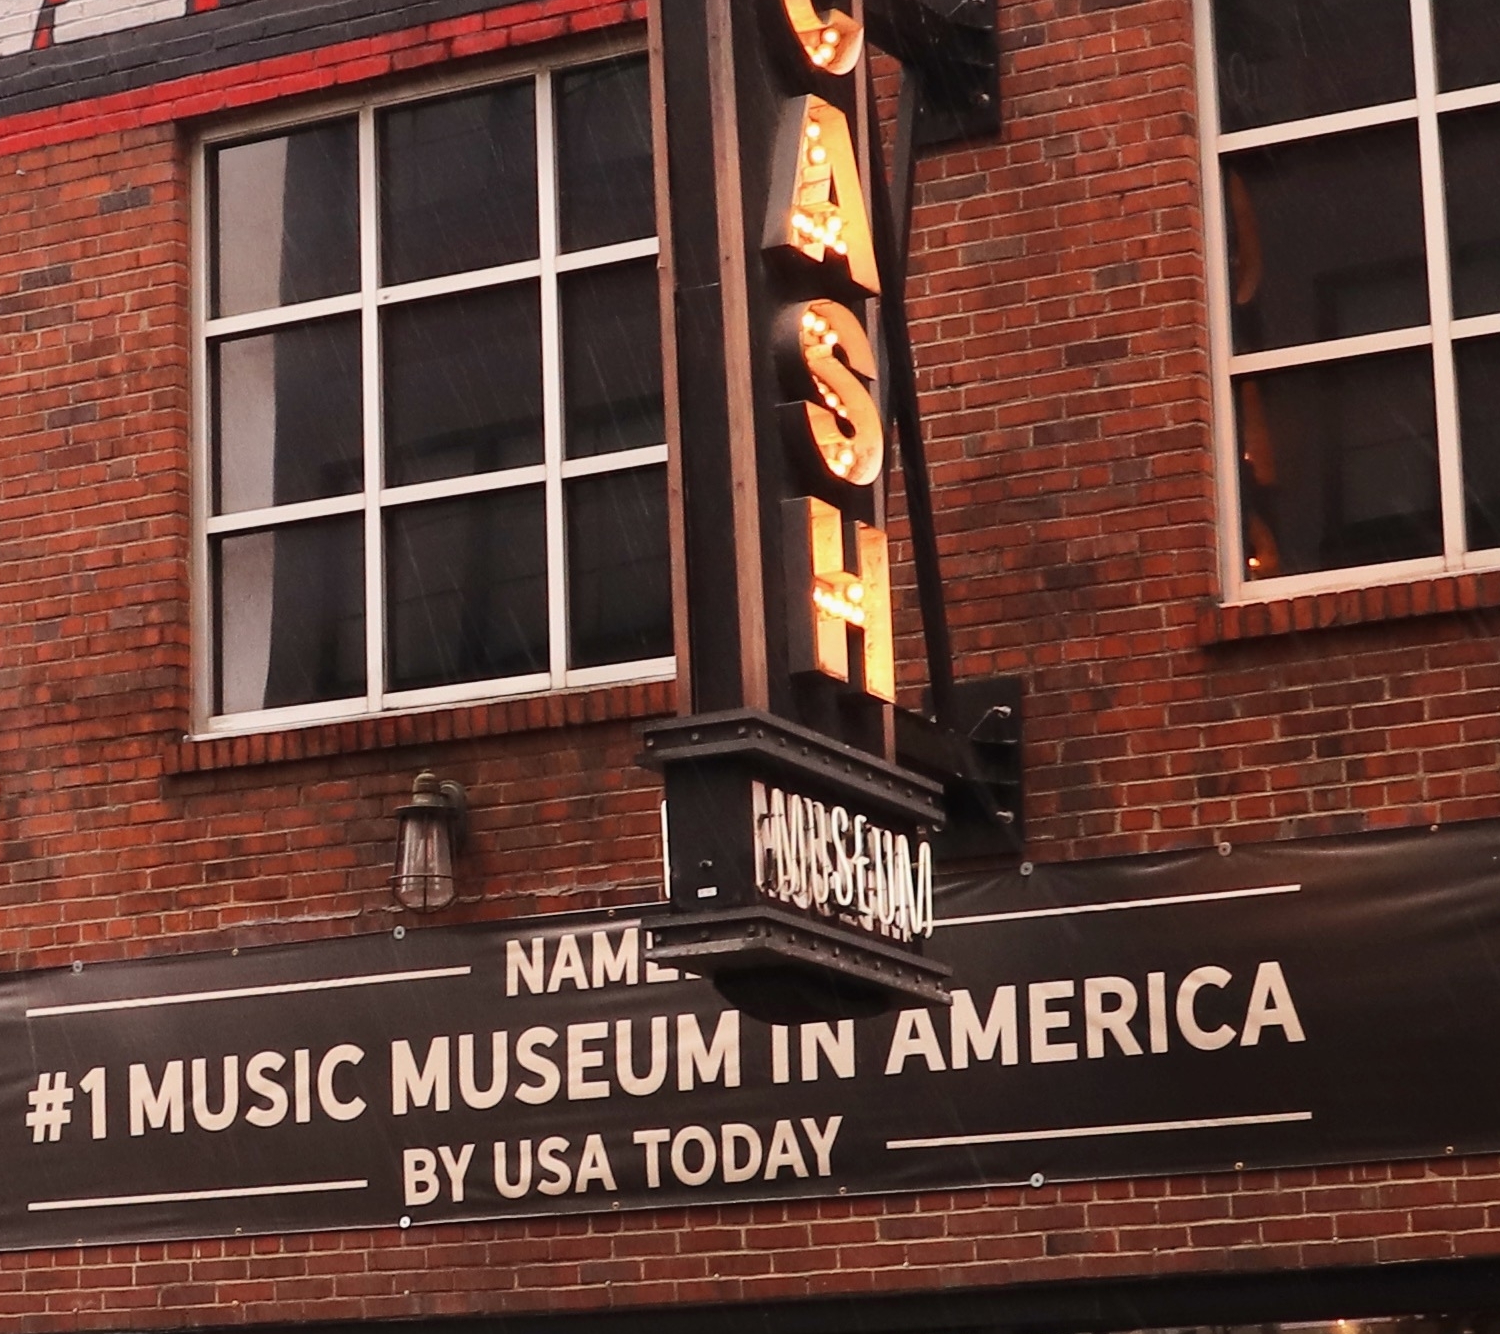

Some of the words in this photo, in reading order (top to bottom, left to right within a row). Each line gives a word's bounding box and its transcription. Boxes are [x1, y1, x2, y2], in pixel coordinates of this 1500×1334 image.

[754, 782, 934, 941] MUSEUM
[26, 1069, 106, 1144] #1
[129, 1045, 367, 1137] MUSIC
[391, 1009, 741, 1116] MUSEUM
[771, 1019, 855, 1082] IN
[885, 960, 1307, 1076] AMERICA
[404, 1143, 474, 1209] BY
[493, 1131, 618, 1202] USA
[633, 1114, 843, 1189] TODAY
